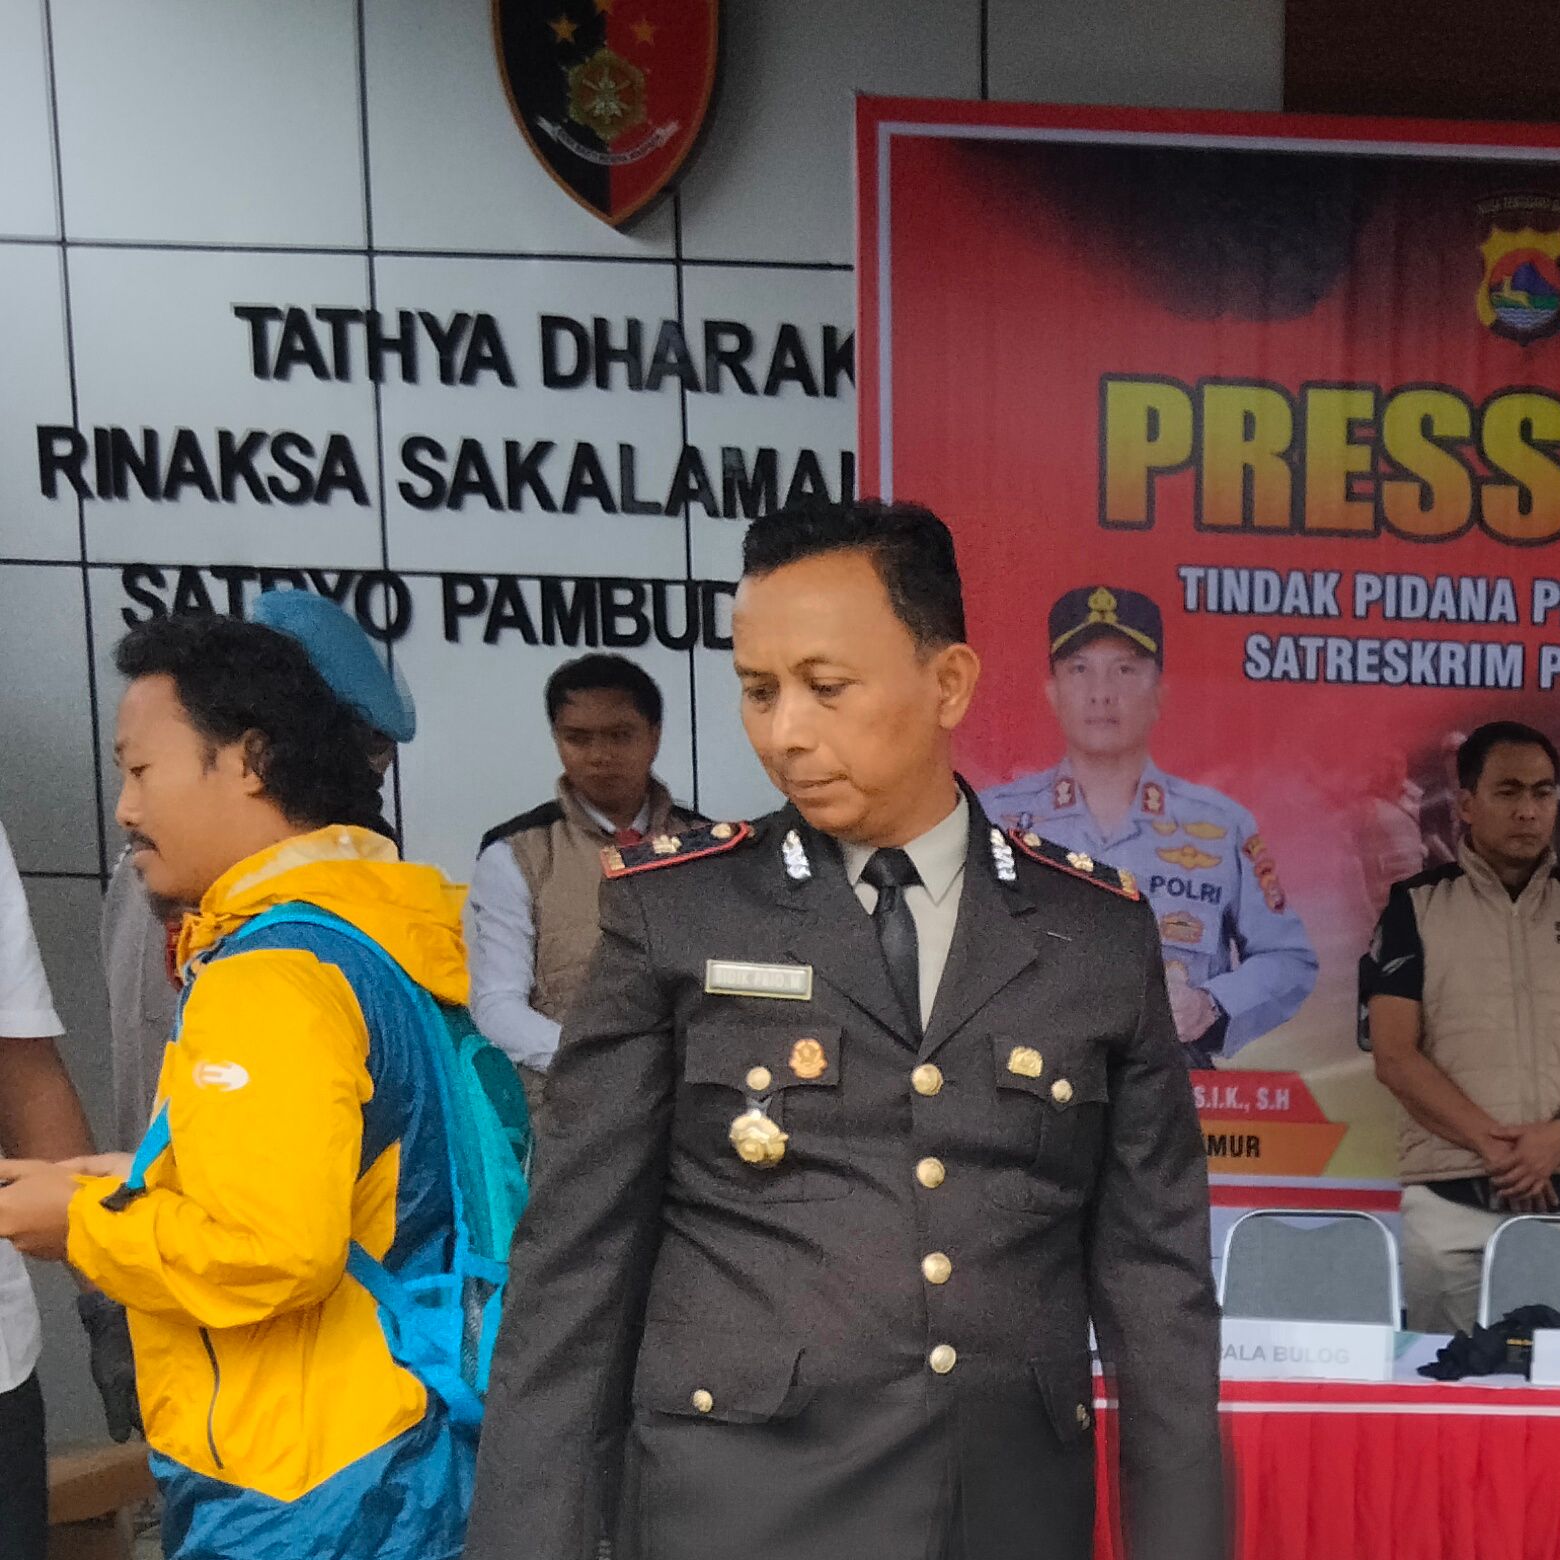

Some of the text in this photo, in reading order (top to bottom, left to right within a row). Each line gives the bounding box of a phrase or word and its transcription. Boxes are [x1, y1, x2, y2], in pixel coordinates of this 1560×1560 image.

[233, 304, 855, 398] TATHYA DHARAK
[36, 424, 371, 507] RINAKSA
[121, 562, 412, 642] SATYO
[1178, 566, 1341, 617] TINDAK
[1354, 571, 1518, 625] PIDANA
[1243, 635, 1525, 690] SATRESKRIM
[1149, 874, 1223, 906] POLRI
[1257, 1087, 1290, 1111] S.H
[1203, 1134, 1261, 1159] MUR
[1222, 1343, 1350, 1366] ALA BULOG
